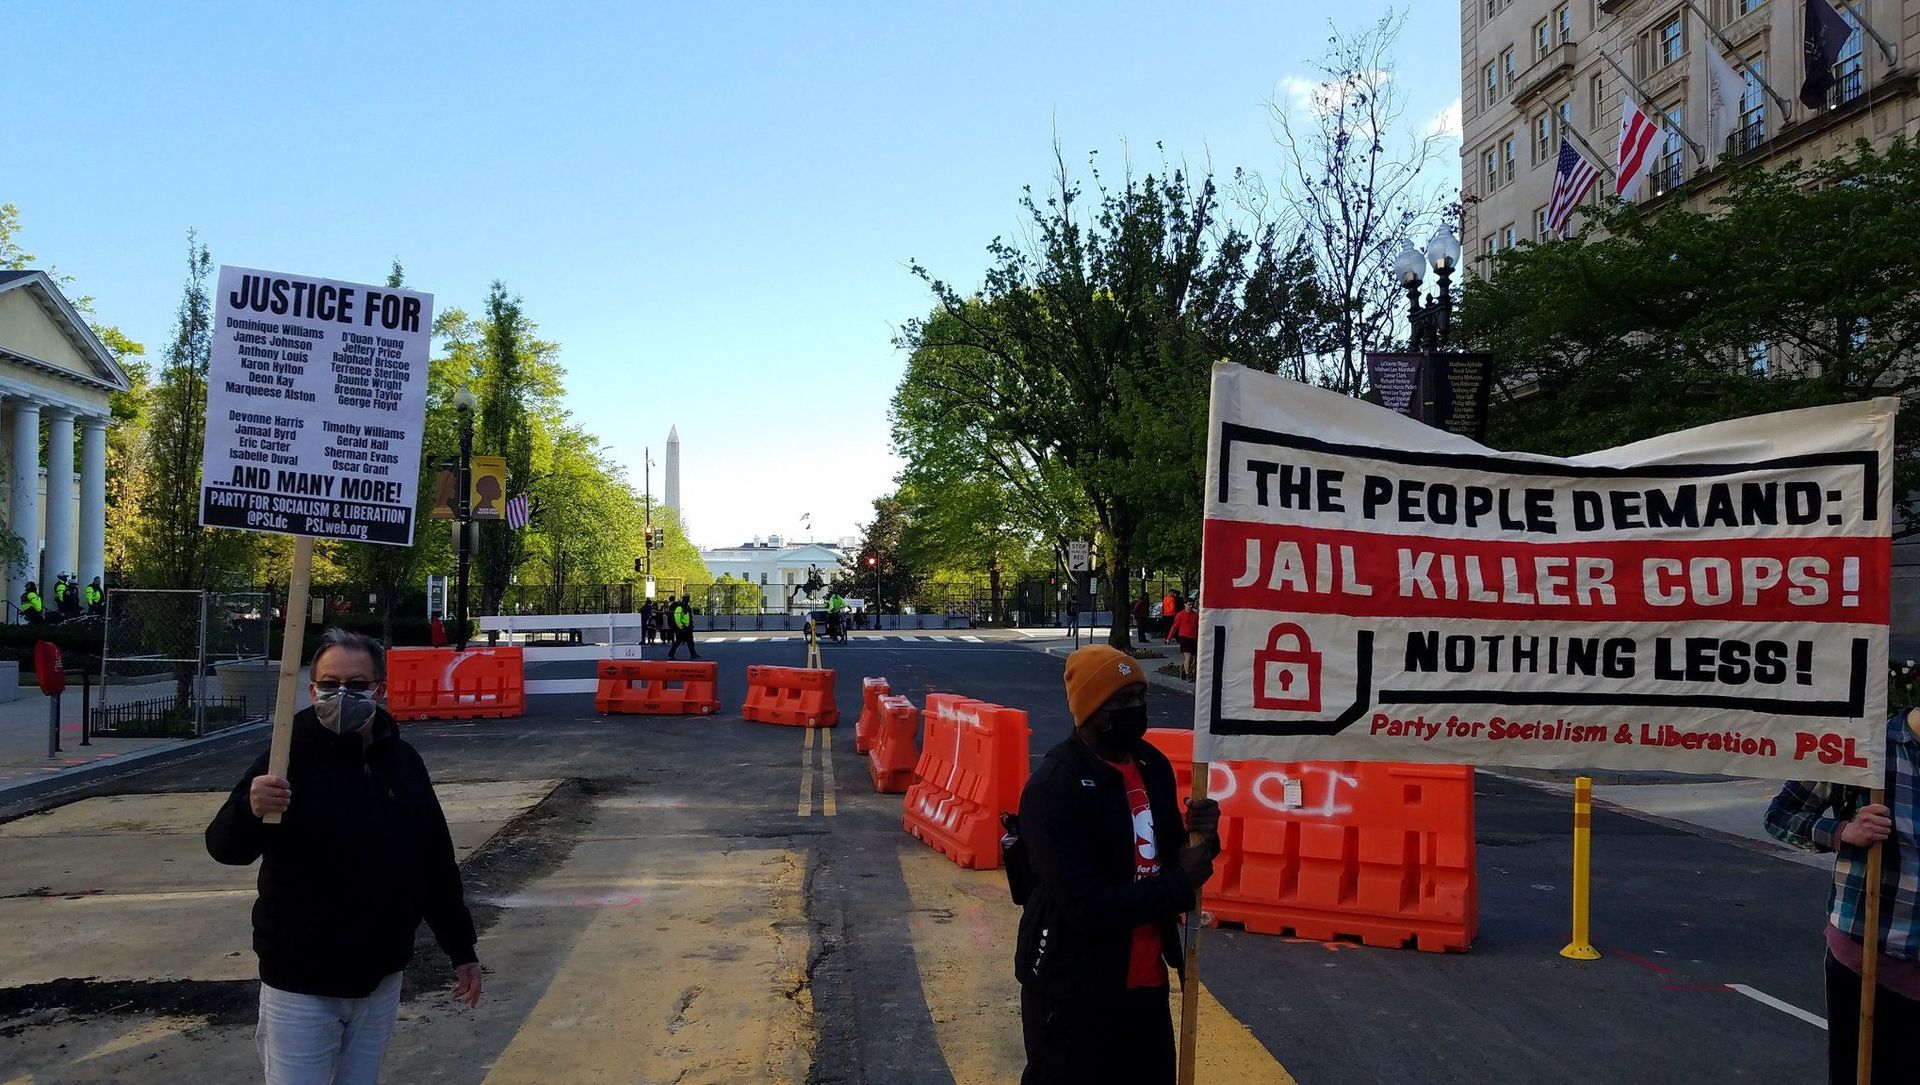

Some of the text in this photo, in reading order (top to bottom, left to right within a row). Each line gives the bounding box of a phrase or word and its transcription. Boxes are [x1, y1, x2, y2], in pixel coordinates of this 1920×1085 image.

[230, 274, 421, 332] JUSTICE FOR
[226, 317, 324, 339] Dominique Williams
[234, 331, 312, 350] James Johnson
[342, 332, 404, 350] D'Quan Young
[238, 344, 308, 363] Anthony Louis
[343, 342, 402, 360] Jeffery Price
[241, 358, 304, 375] Karon Hylton
[332, 352, 410, 370] Ralphael Briscoe
[249, 372, 294, 388] Deon Kay
[331, 362, 410, 382] Terrence Sterling
[337, 374, 402, 390] Daunte Wright
[226, 382, 316, 402] Marqueese Alston
[334, 384, 403, 401] Breonna Taylor
[338, 394, 398, 411] George Floyd
[229, 410, 304, 428] Devonne Harris
[235, 424, 296, 440] Jamaal Byrd
[322, 420, 405, 440] Timothy Williams
[240, 436, 290, 452] Eric Carter
[336, 435, 389, 450] Gerald Hall
[230, 448, 298, 466] Isabelle Duval
[324, 446, 399, 464] Sherman Evans
[332, 460, 388, 475] Oscar Grant
[213, 465, 402, 504] ...AND MANY MORE!
[1247, 459, 1843, 534] THE PEOPLE DEMAND:
[210, 490, 406, 524] PARTY FOR SOCIALISM & LIBERATION
[248, 510, 368, 540] @PSLdc PSLweb.org
[1232, 539, 1860, 607] JAIL KILLER COPS!
[1404, 630, 1813, 686] NOTHING LESS!
[1370, 714, 1868, 768] Party for Socialism & Liberation PSL
[1137, 864, 1150, 873] for
